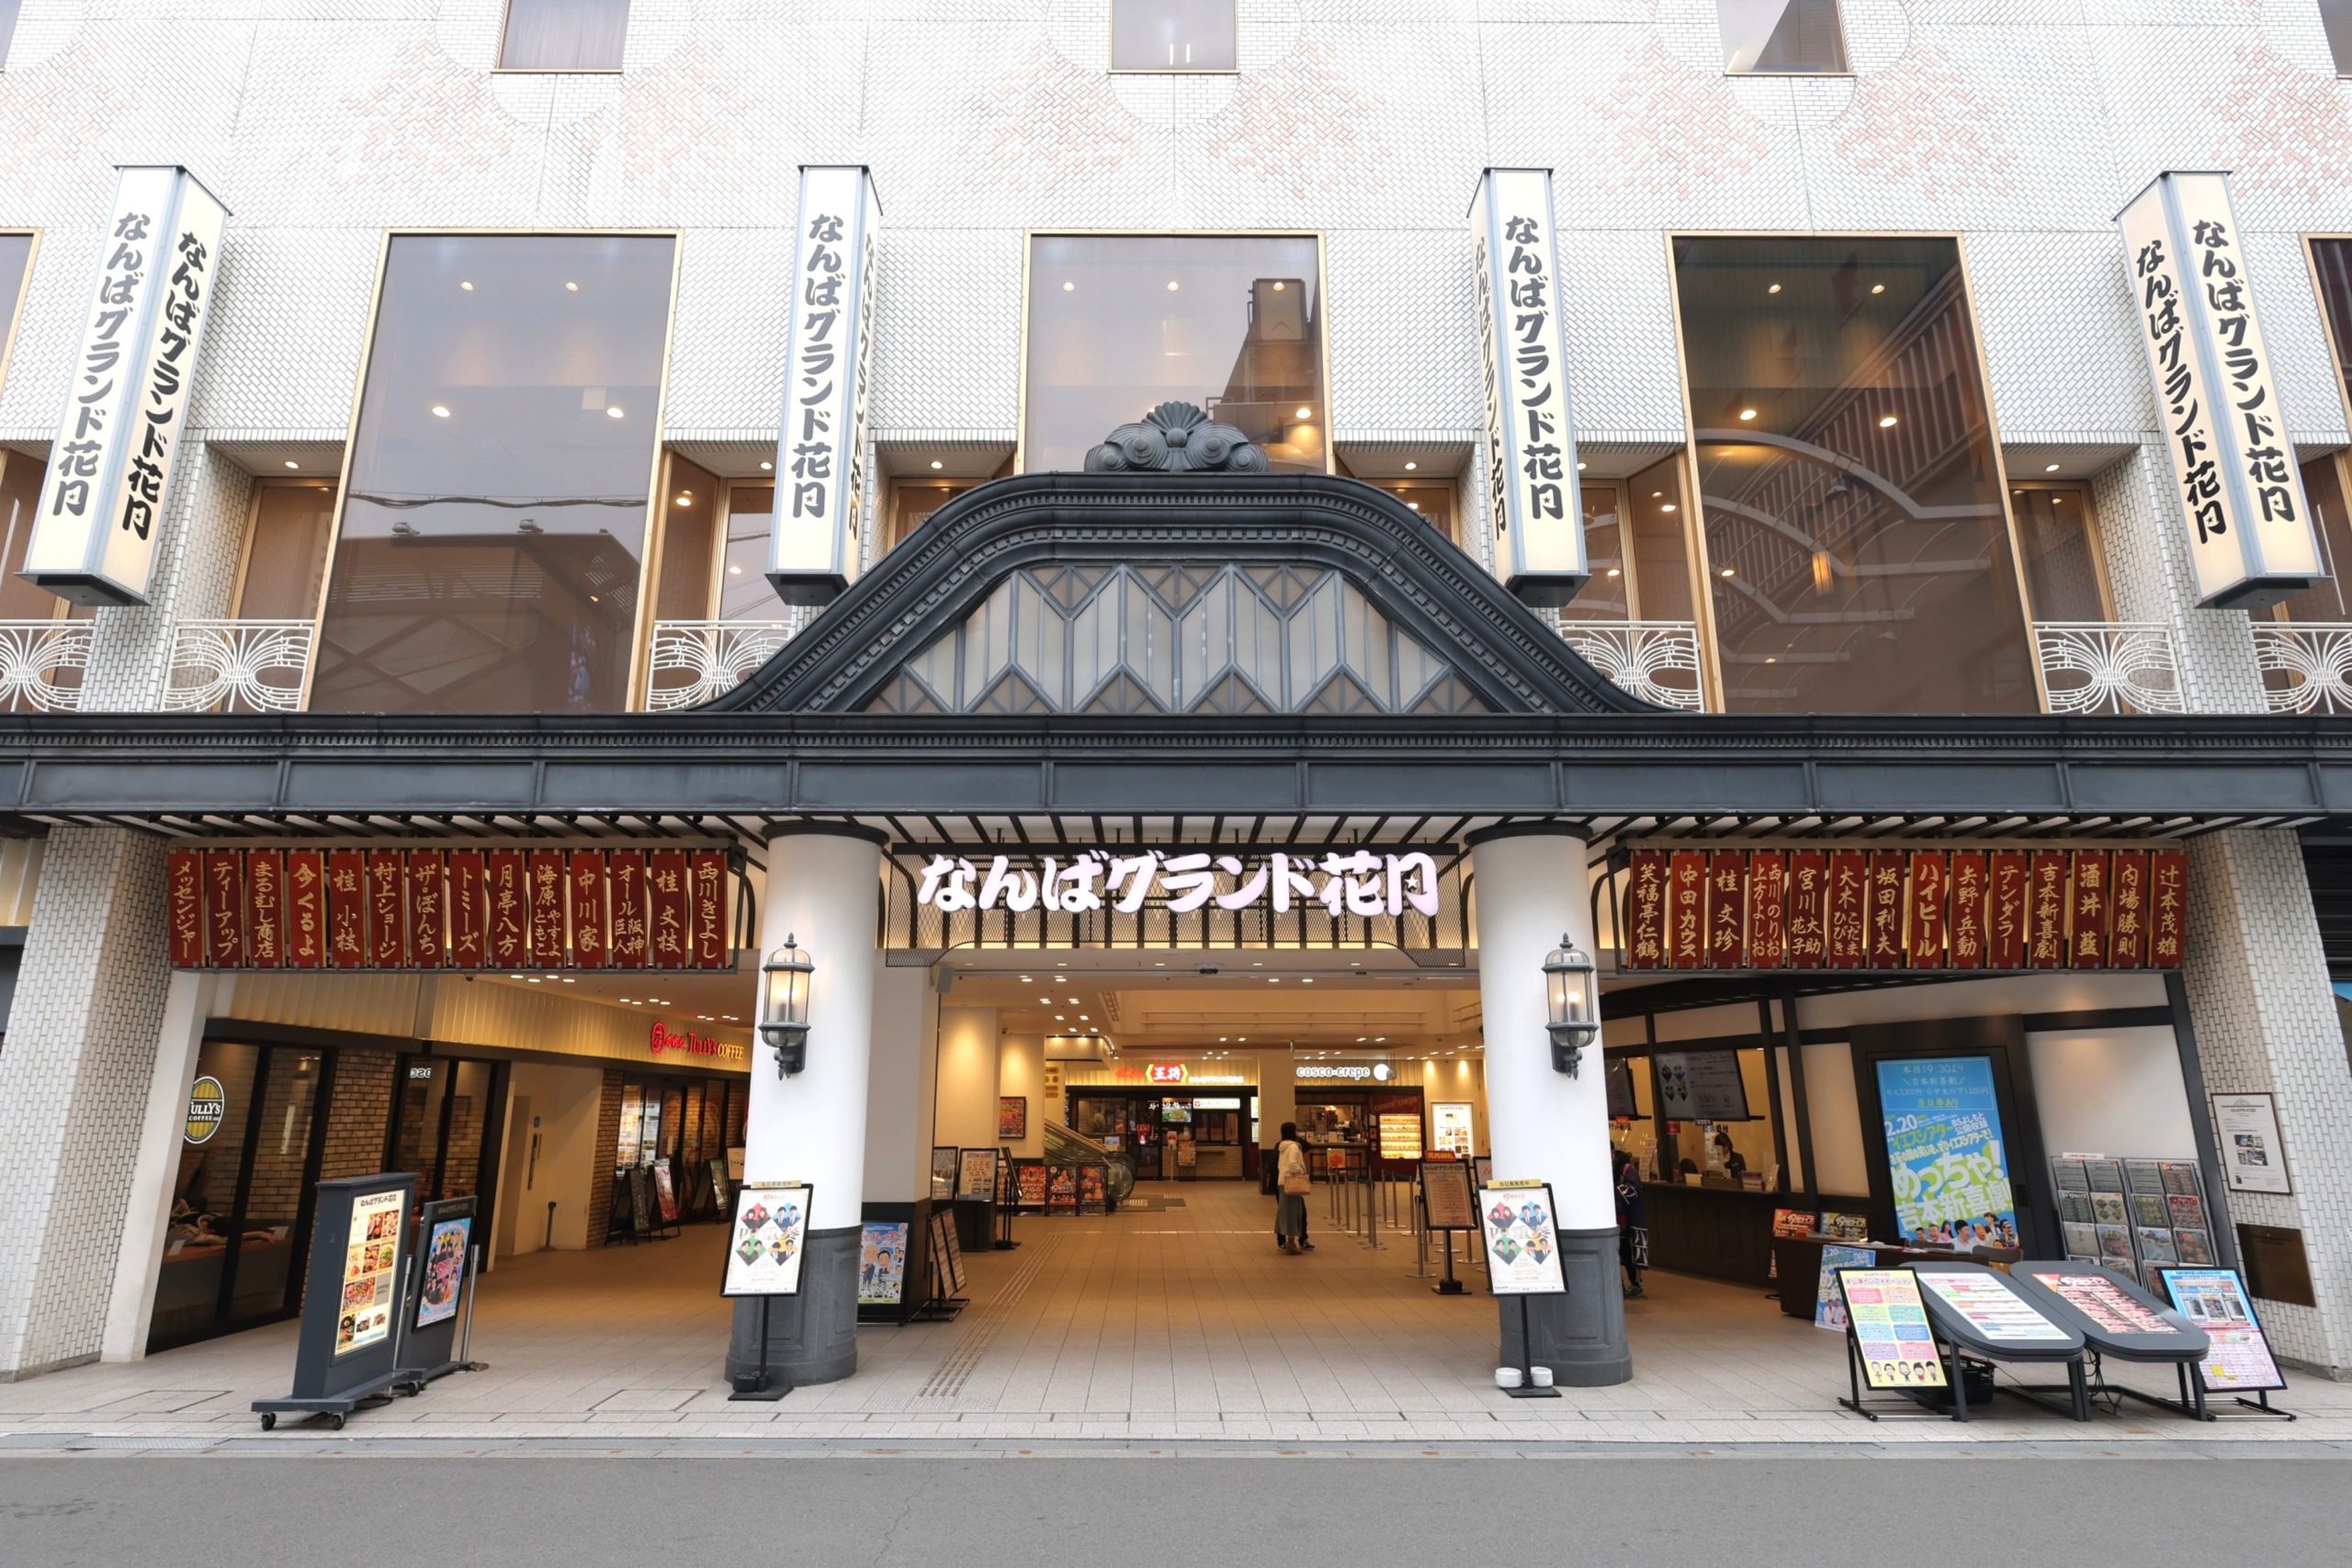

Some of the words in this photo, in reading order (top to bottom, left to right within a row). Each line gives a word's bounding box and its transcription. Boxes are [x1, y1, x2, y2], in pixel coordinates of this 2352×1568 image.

[52, 212, 152, 518] なんばグランド花月
[121, 231, 208, 541] なんばグランド花月
[791, 213, 845, 519] なんばグランド花月
[1505, 214, 1565, 521] なんばグランド花月
[2135, 239, 2228, 545] なんばグランド花月
[2193, 219, 2297, 524] なんばグランド花月
[174, 861, 197, 958] メッセンジャー
[213, 863, 239, 957] ティーアップ
[254, 861, 275, 958] まるむし商店
[374, 863, 396, 958] 村上ショージ
[459, 867, 478, 953] トミーズ
[497, 863, 518, 957] 月亭八方
[578, 869, 599, 953] 中川家
[698, 862, 718, 959] 西川きよし
[916, 848, 1440, 918] なんばグランド花月
[1635, 863, 1660, 960] 笑福亭仁鶴
[1679, 863, 1698, 957] 中田カウス
[1752, 863, 1767, 957] 上方よしお
[1767, 863, 1781, 957] 西川のりお
[1874, 867, 1899, 955] 坂田利夫
[1917, 863, 1939, 957] ハイヒール
[1997, 865, 2019, 957] テンダラー
[2034, 863, 2060, 959] 吉本新喜劇
[2117, 863, 2141, 958] 内場勝則
[2157, 864, 2182, 956] 辻本茂雄
[718, 1043, 744, 1059] COFFEE
[1153, 1066, 1182, 1080] 王将
[190, 1101, 220, 1114] ULLY'S
[1884, 1114, 1918, 1136] 2.20
[1896, 1177, 2013, 1231] 吉本新喜劇
